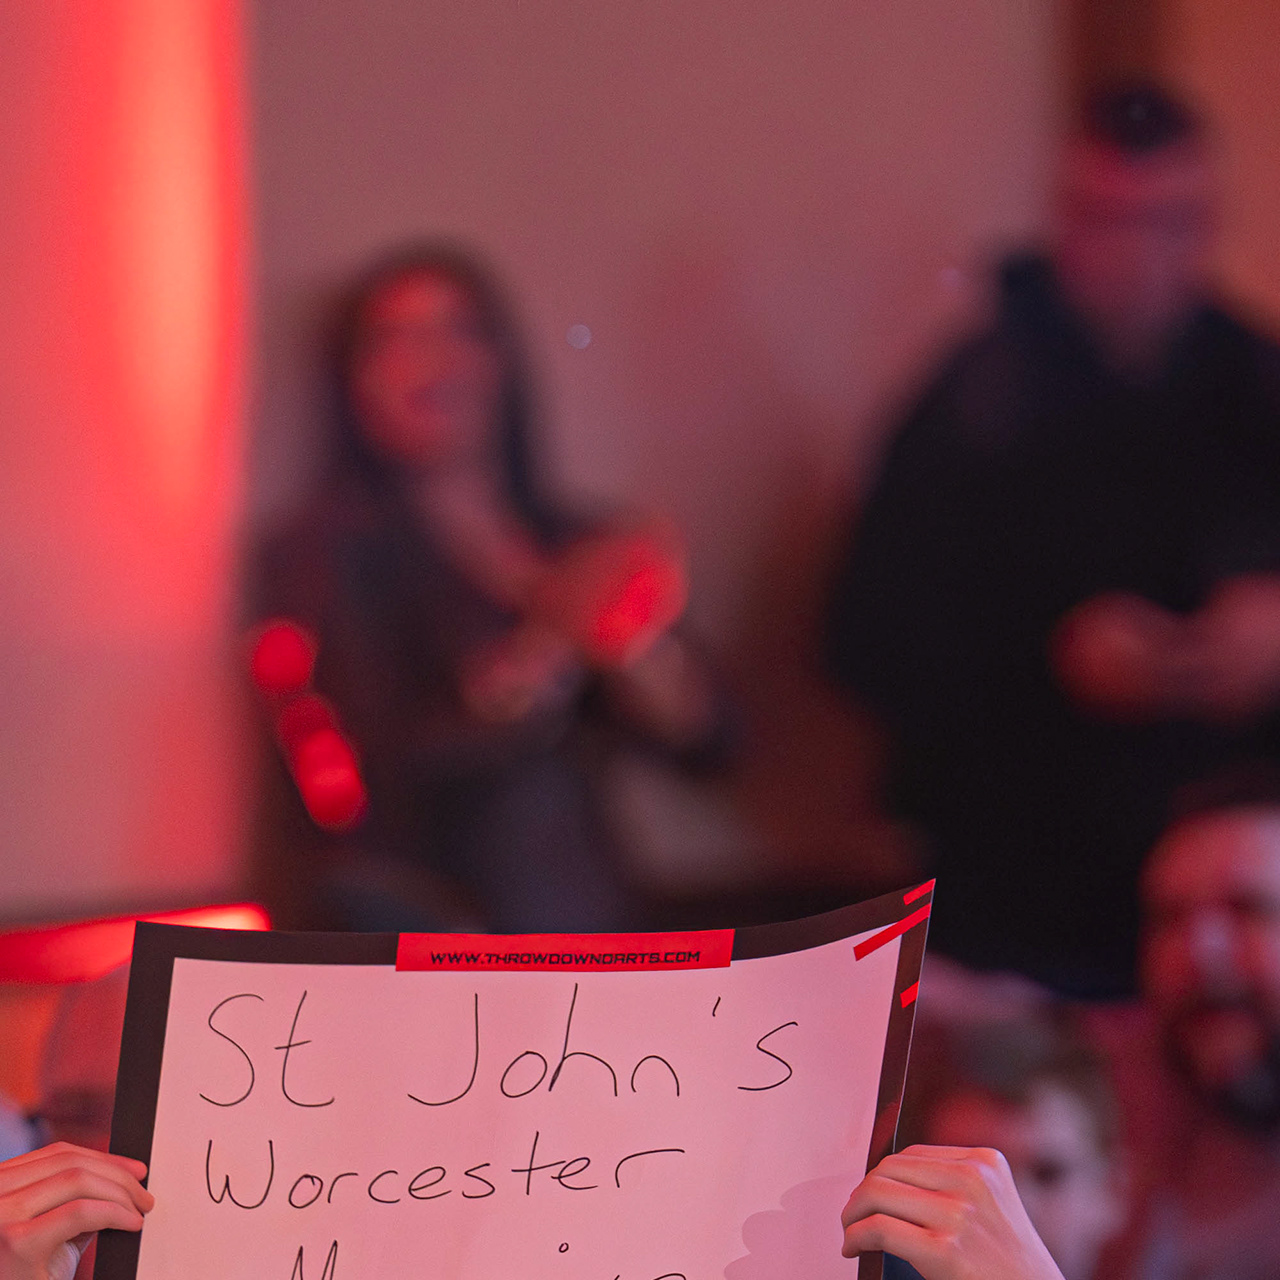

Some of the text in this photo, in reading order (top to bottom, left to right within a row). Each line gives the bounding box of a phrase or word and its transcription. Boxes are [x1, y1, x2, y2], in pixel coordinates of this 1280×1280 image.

[430, 950, 701, 965] WWW.THROWDOWNDARTS.COM
[198, 982, 799, 1108] St John's
[205, 1130, 686, 1210] Worcester
